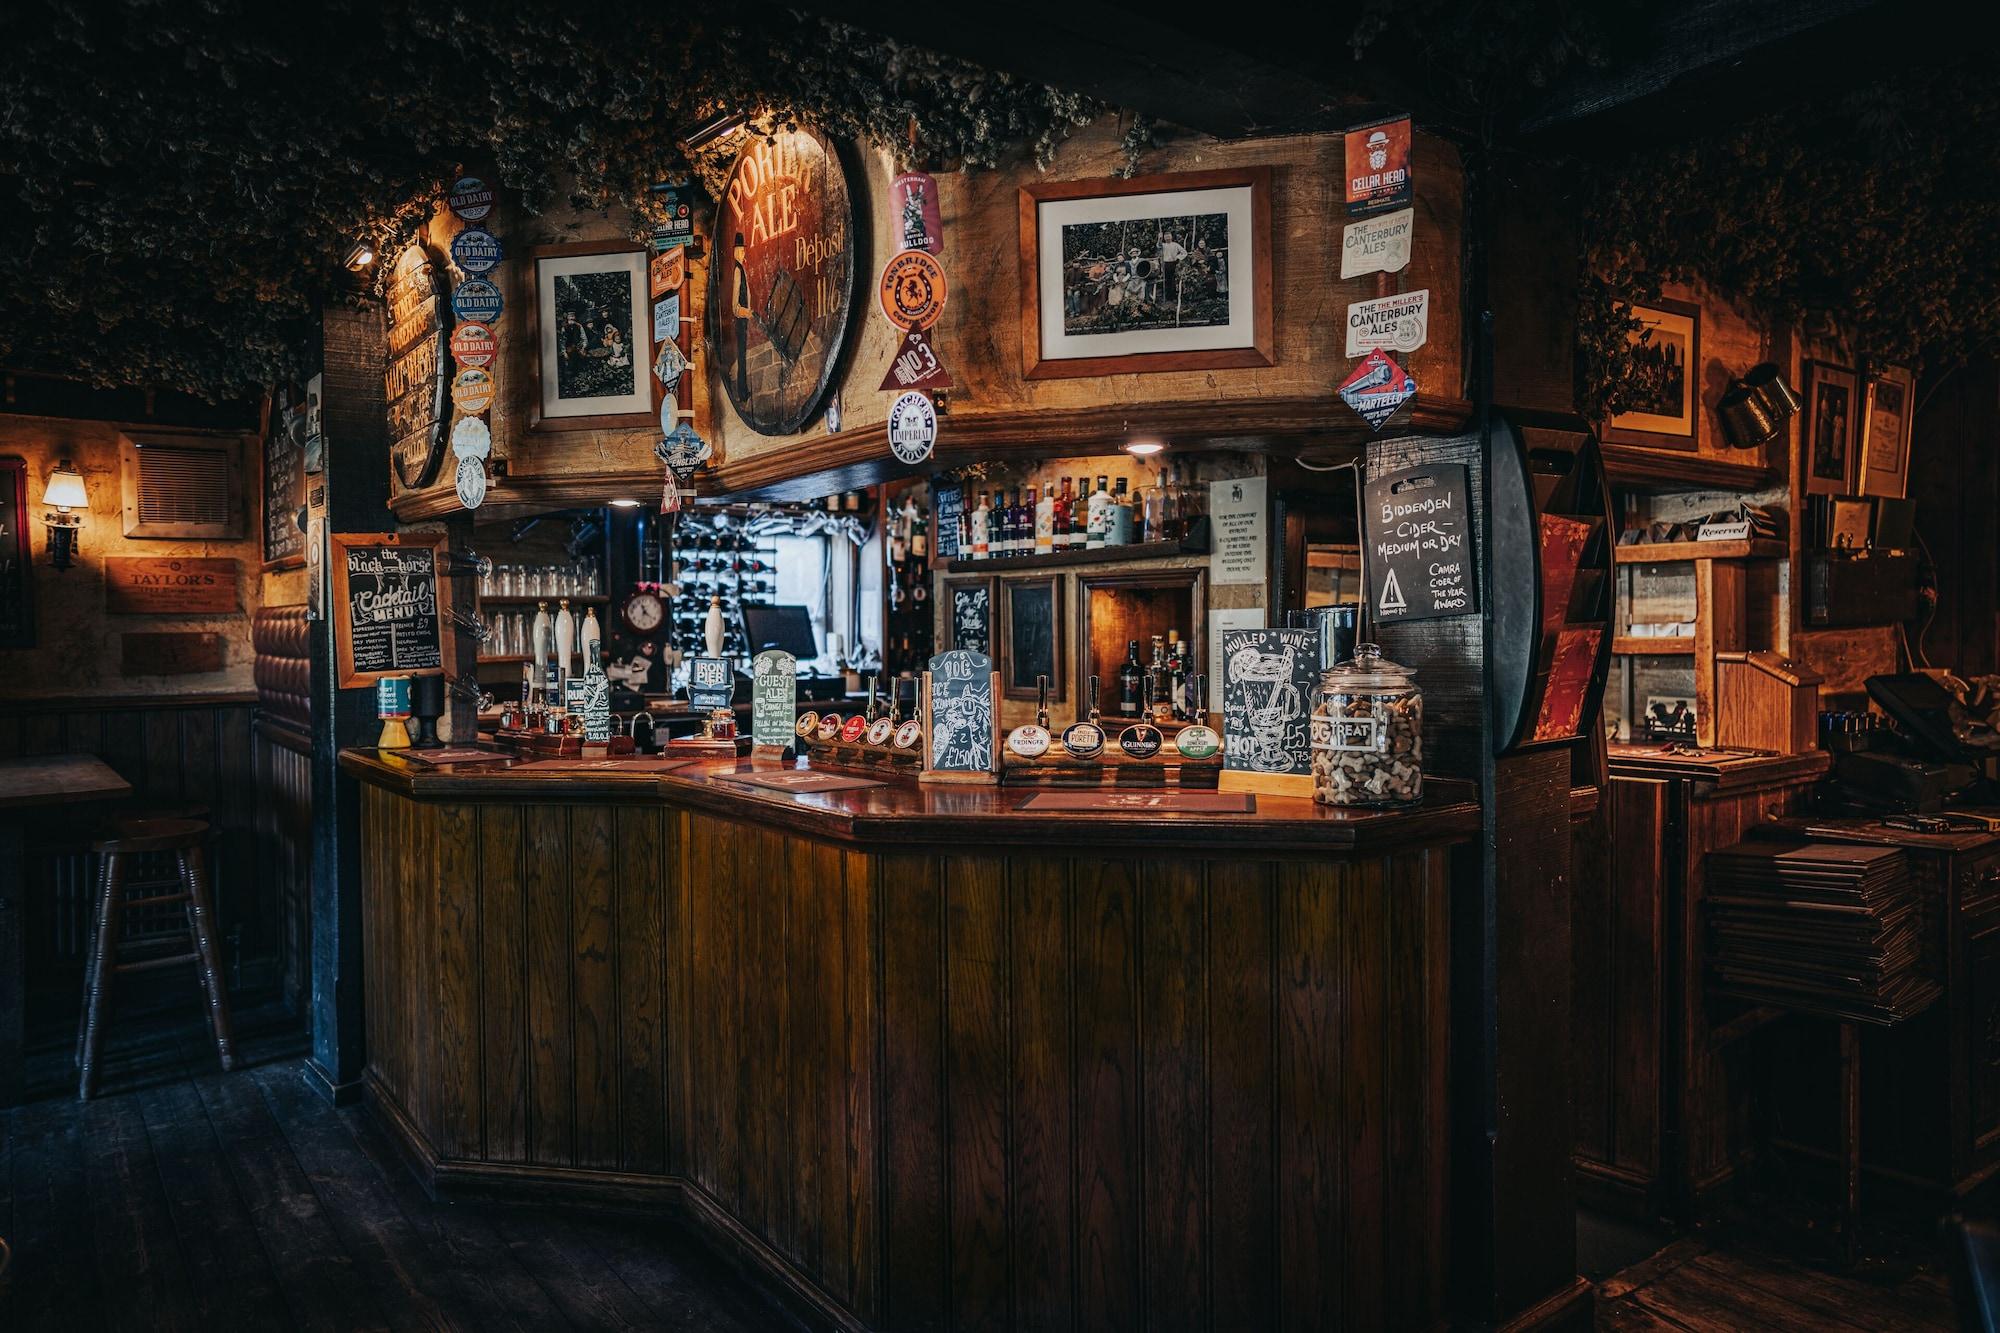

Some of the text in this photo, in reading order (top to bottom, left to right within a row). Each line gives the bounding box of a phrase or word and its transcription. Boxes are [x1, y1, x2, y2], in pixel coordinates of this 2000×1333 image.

[1352, 168, 1405, 191] CELLAR HEAD
[450, 191, 492, 208] OLD DAIRY
[750, 184, 798, 248] ALE
[1346, 223, 1408, 248] CANTERBURY
[1354, 225, 1368, 236] THE
[455, 246, 498, 257] OLD DAIRY
[1362, 241, 1386, 256] ALES
[885, 257, 937, 291] TONBRIDGE
[456, 297, 499, 308] OLD DAIRY
[1360, 304, 1376, 315] THE
[1392, 295, 1424, 307] MILLER'S
[1350, 303, 1423, 328] CANTERBURY
[1370, 321, 1398, 336] ALES
[454, 340, 494, 351] OLD DAIRY
[897, 350, 922, 384] NO
[918, 343, 936, 368] 3
[455, 384, 491, 399] OLD DAIRY
[1358, 394, 1403, 412] MARTELLO
[895, 429, 929, 441] IMPERIAL
[895, 441, 929, 461] STOUT
[671, 455, 701, 468] ENGLISH
[1382, 492, 1451, 523] BIDDENDEN
[1397, 520, 1446, 538] CIDER
[1701, 524, 1747, 537] Reserved
[381, 548, 398, 560] the
[1378, 534, 1462, 563] MEDIUM OR DRY
[348, 557, 431, 574] black horse
[1429, 562, 1460, 577] CAMRA
[130, 574, 215, 586] TAYLOR'S
[1430, 576, 1454, 589] CIDER
[360, 582, 429, 612] Cocktail
[955, 591, 970, 607] Gin
[1431, 586, 1467, 598] THE YEAR
[1433, 599, 1466, 611] AWARD
[373, 605, 414, 622] MENU
[1225, 632, 1310, 657] MULLED WINE
[696, 662, 725, 673] IRON
[944, 660, 972, 678] DOG
[696, 671, 725, 682] PIER
[759, 675, 792, 688] GUEST
[766, 688, 788, 699] ALES
[932, 682, 950, 698] ICE
[1225, 701, 1246, 716] Spicy
[1330, 723, 1369, 737] TREAT
[1071, 733, 1095, 743] PORETTI
[1124, 740, 1157, 749] GUINNESS
[1225, 734, 1260, 756] HOT
